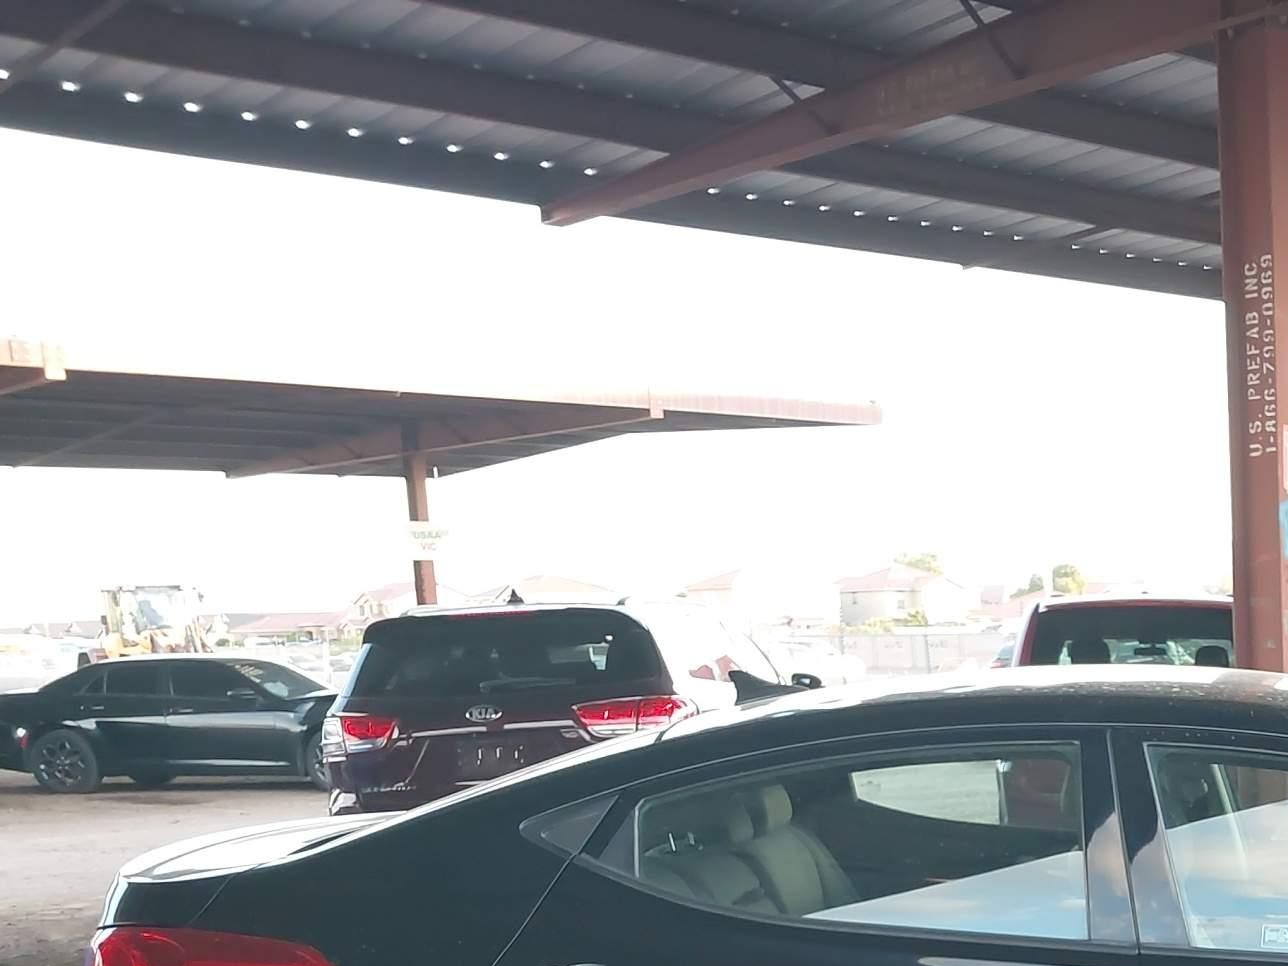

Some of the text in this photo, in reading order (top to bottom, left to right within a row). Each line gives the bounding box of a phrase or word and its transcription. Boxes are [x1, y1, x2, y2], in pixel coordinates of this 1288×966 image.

[1244, 263, 1263, 457] U.S. PREFAB INC
[469, 707, 497, 720] KIA
